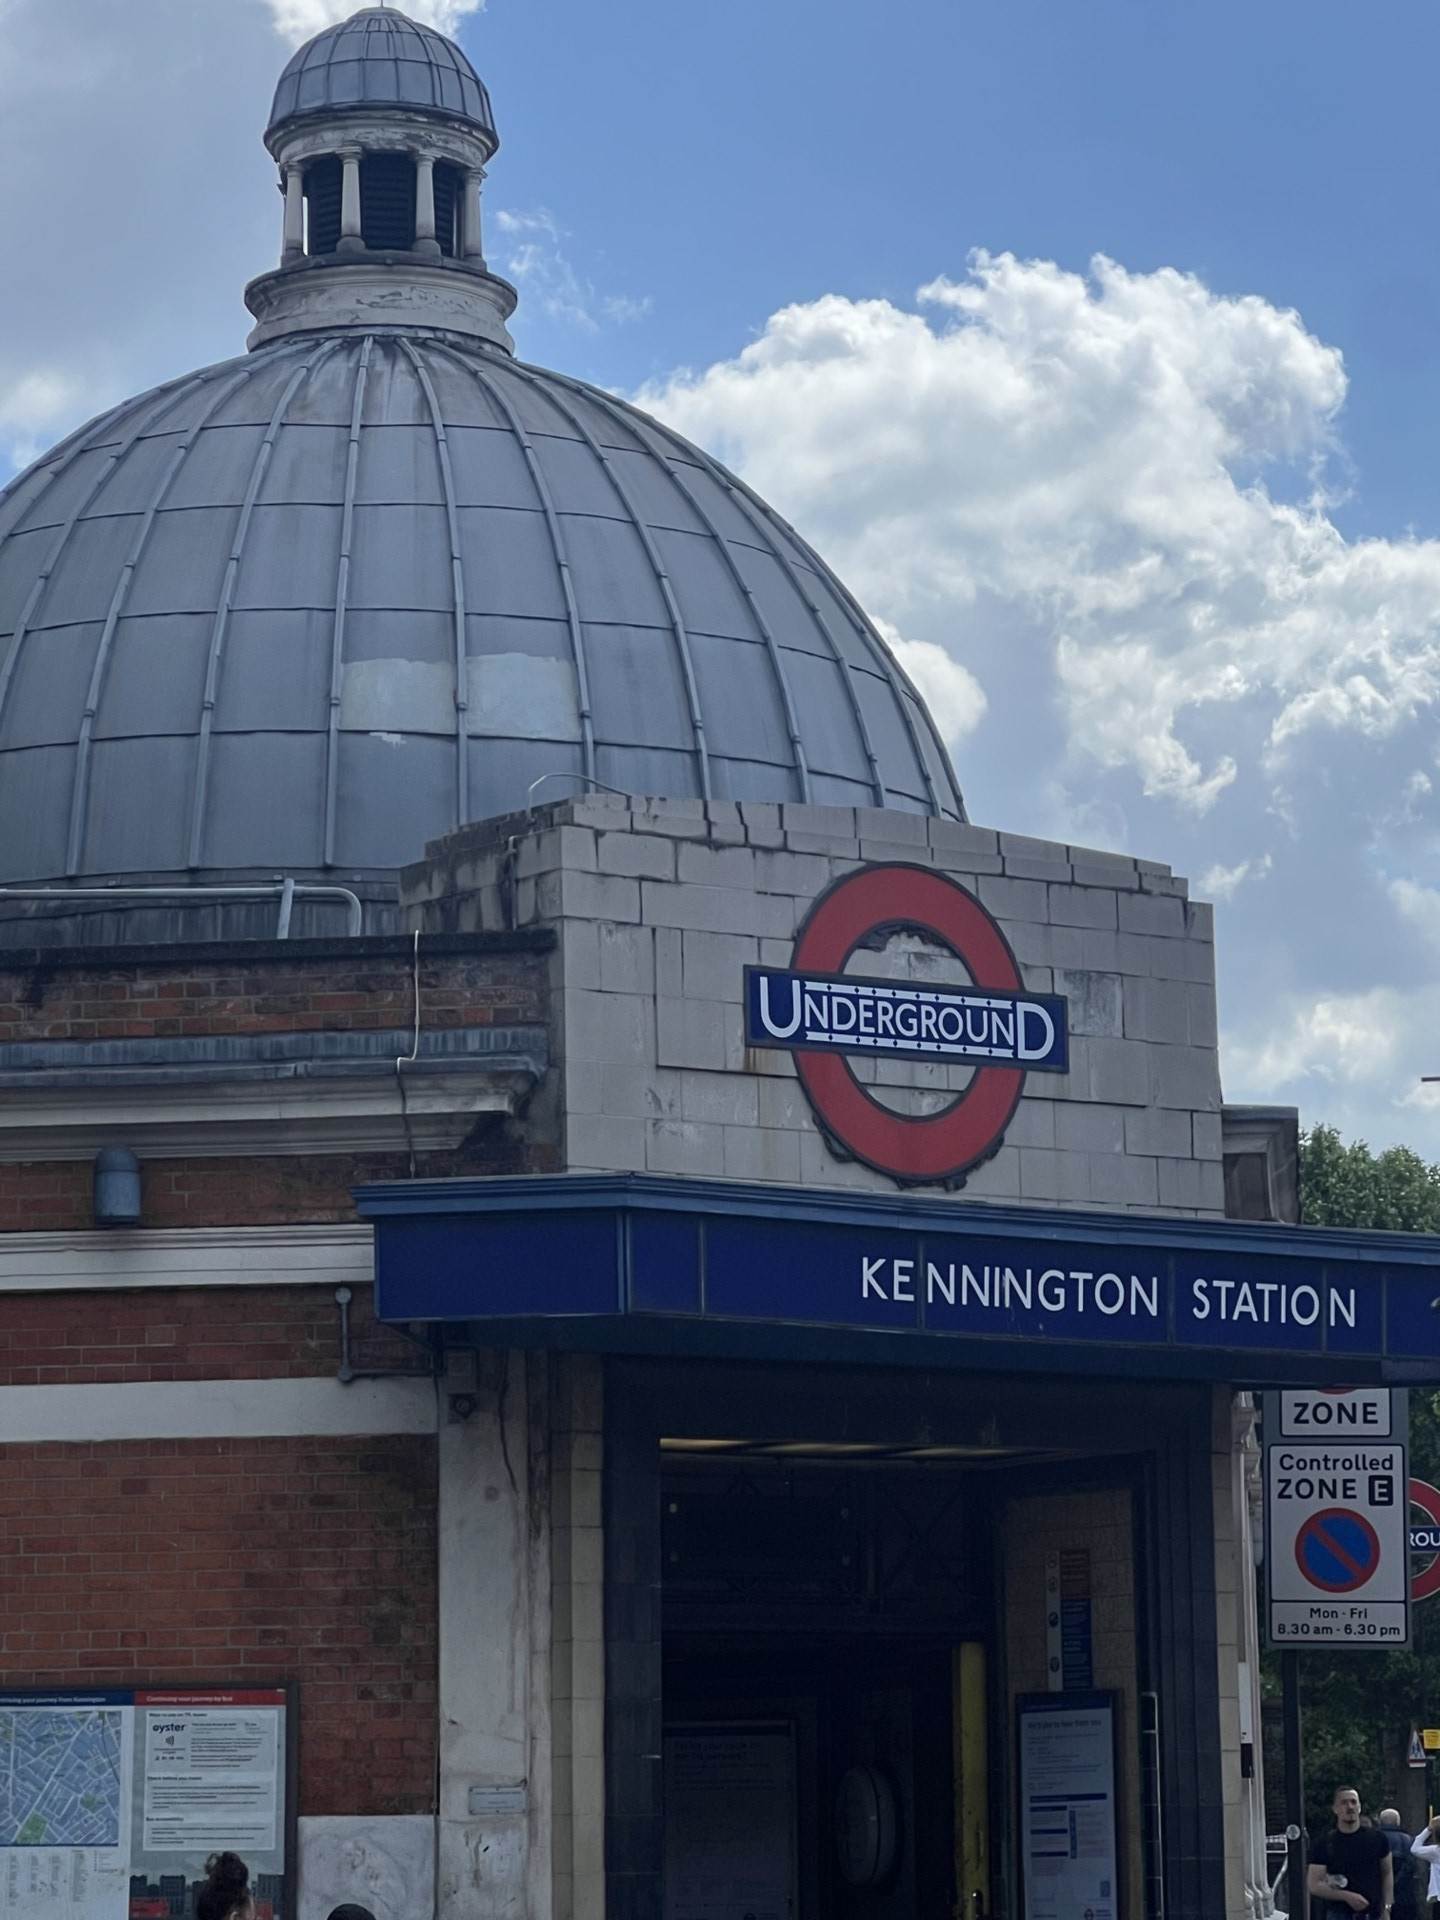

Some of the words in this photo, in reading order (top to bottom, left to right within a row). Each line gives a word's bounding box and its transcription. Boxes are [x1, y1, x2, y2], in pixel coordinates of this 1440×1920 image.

[758, 975, 1056, 1061] UNDERGROUND
[861, 1256, 1159, 1318] KENNINGTON
[1192, 1277, 1357, 1329] STATION
[1293, 1401, 1379, 1425] ZONE
[1279, 1453, 1394, 1471] Controlled
[1277, 1478, 1358, 1500] ZONE
[1373, 1479, 1390, 1502] E
[1309, 1607, 1339, 1619] Mon
[1350, 1607, 1368, 1619] Fri
[1277, 1623, 1310, 1636] 8.30
[1313, 1625, 1334, 1636] am
[1344, 1623, 1377, 1636] 6.30
[1380, 1625, 1401, 1638] pm
[152, 1722, 186, 1734] oyster
